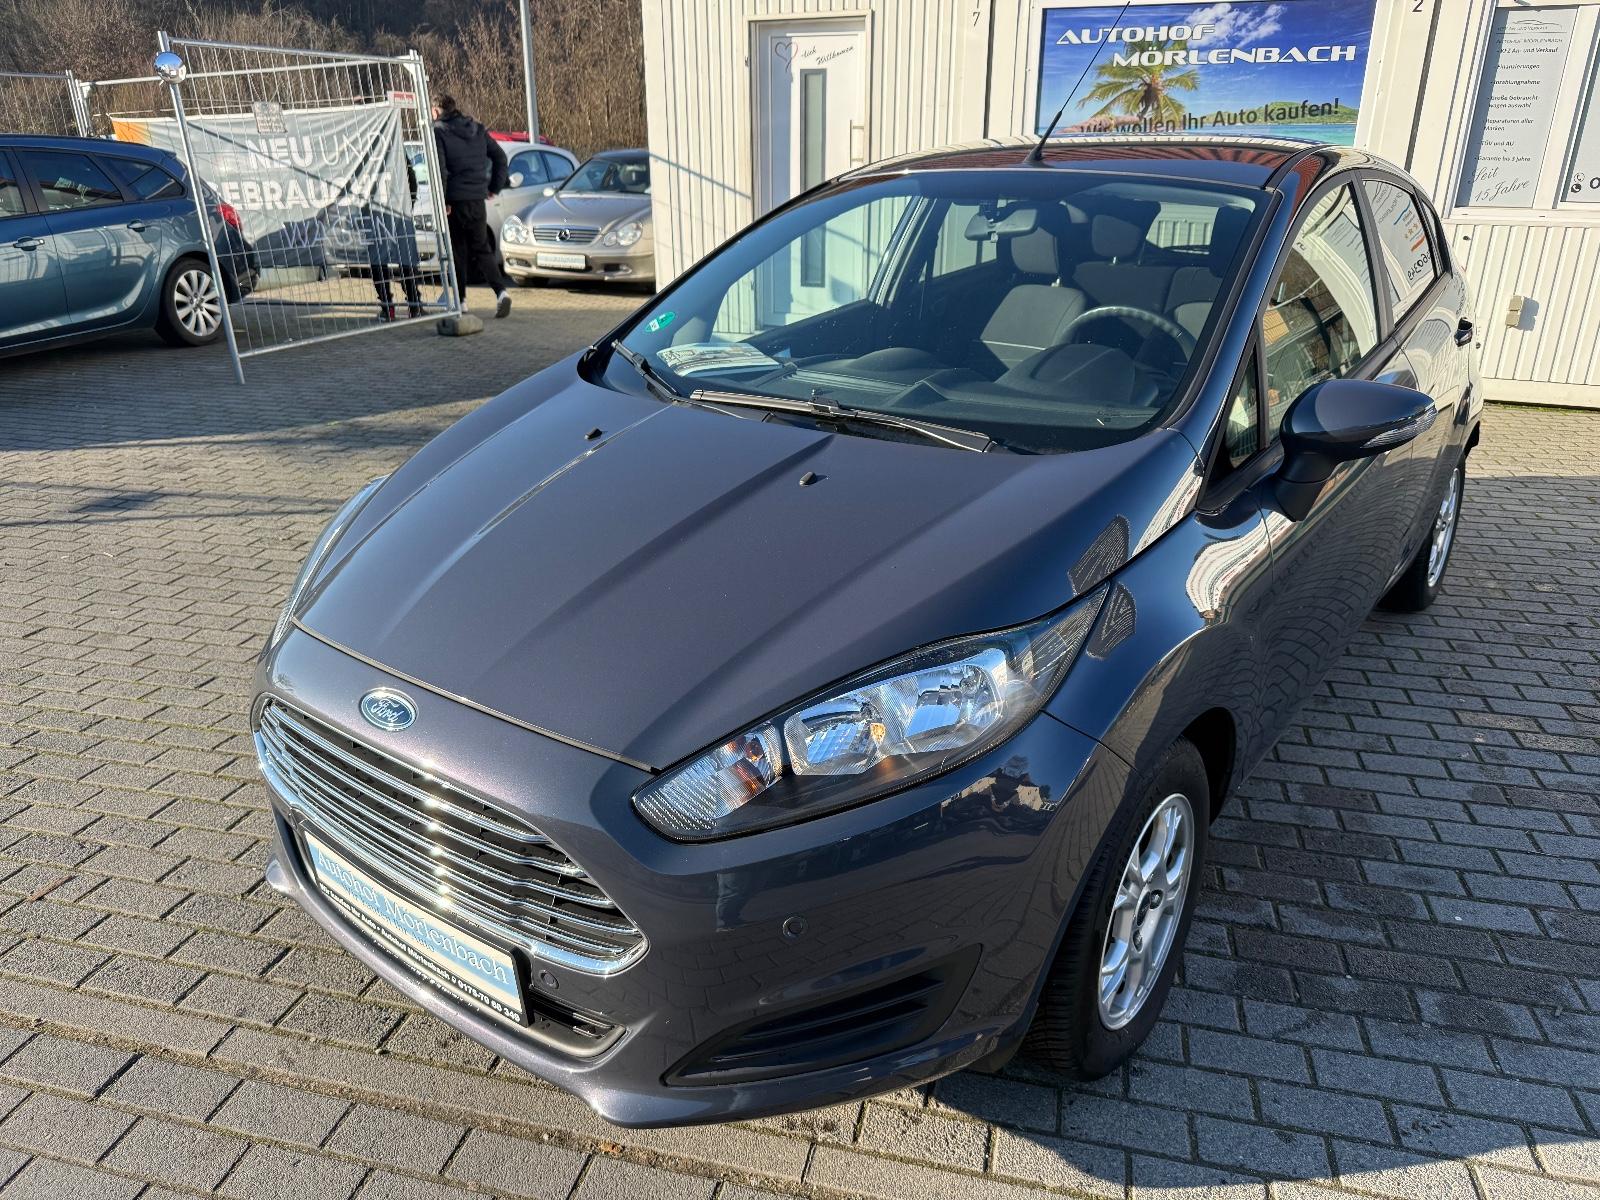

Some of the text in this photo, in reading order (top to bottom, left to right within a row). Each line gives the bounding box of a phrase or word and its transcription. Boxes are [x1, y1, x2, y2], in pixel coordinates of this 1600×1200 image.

[1412, 0, 1424, 13] 2
[972, 11, 981, 28] 7
[1056, 24, 1216, 45] AUTOHOF
[1112, 45, 1357, 68] MÖRLENBACH
[1115, 116, 1175, 134] wollen
[1182, 112, 1207, 130] Ihr
[1212, 109, 1258, 128] Auto
[1264, 98, 1339, 122] kaufen!
[246, 135, 314, 169] NEU
[1489, 178, 1530, 201] Jahre
[283, 214, 399, 249] WAGEN
[371, 698, 405, 722] Ford
